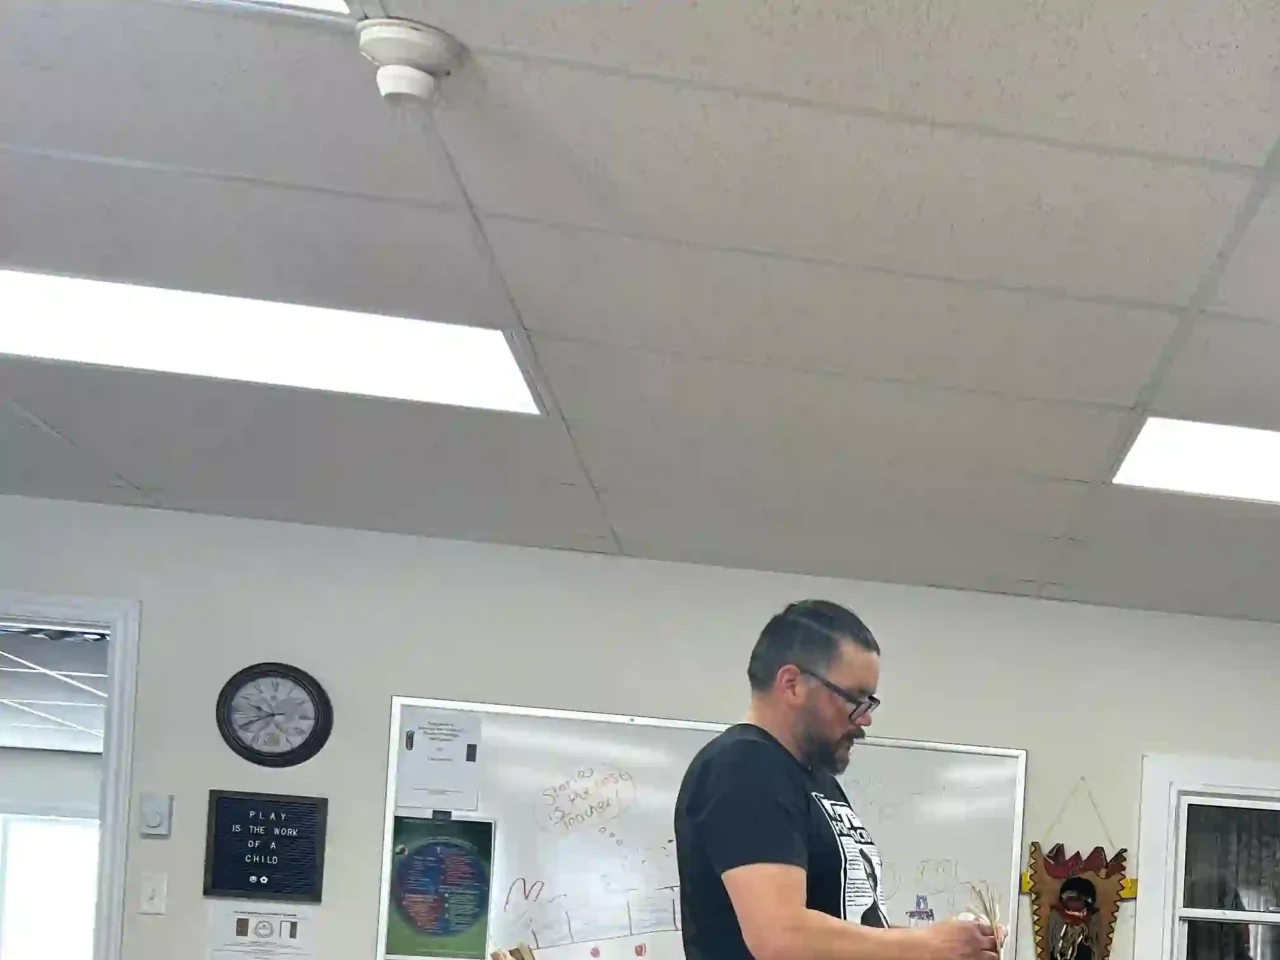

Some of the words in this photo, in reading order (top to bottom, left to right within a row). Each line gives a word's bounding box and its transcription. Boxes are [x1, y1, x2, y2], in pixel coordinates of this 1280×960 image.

[248, 810, 287, 821] PLAY
[231, 824, 241, 833] IS
[249, 825, 266, 835] THE
[273, 827, 299, 837] WORK
[247, 840, 260, 848] OF
[270, 841, 277, 850] A
[245, 854, 279, 865] CHILD
